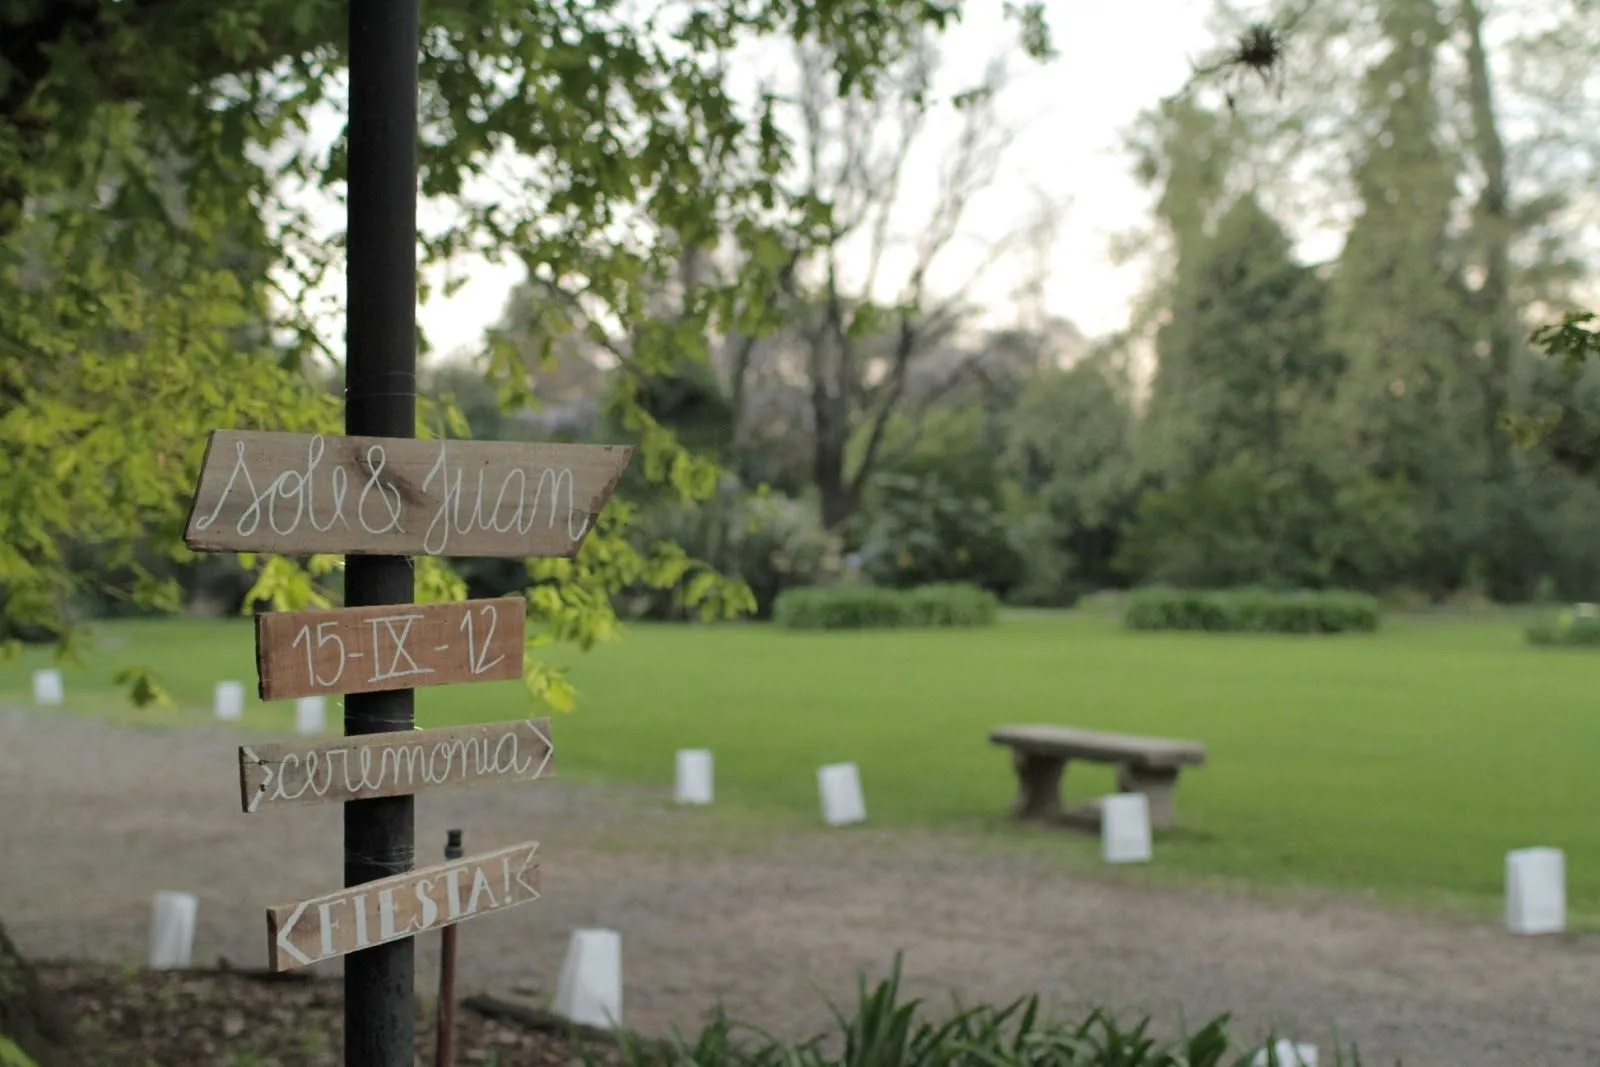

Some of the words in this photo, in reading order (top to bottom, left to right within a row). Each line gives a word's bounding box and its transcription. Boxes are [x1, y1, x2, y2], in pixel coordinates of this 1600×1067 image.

[358, 444, 406, 534] &
[270, 732, 531, 801] ceremonia
[318, 857, 513, 957] FIESTA!
